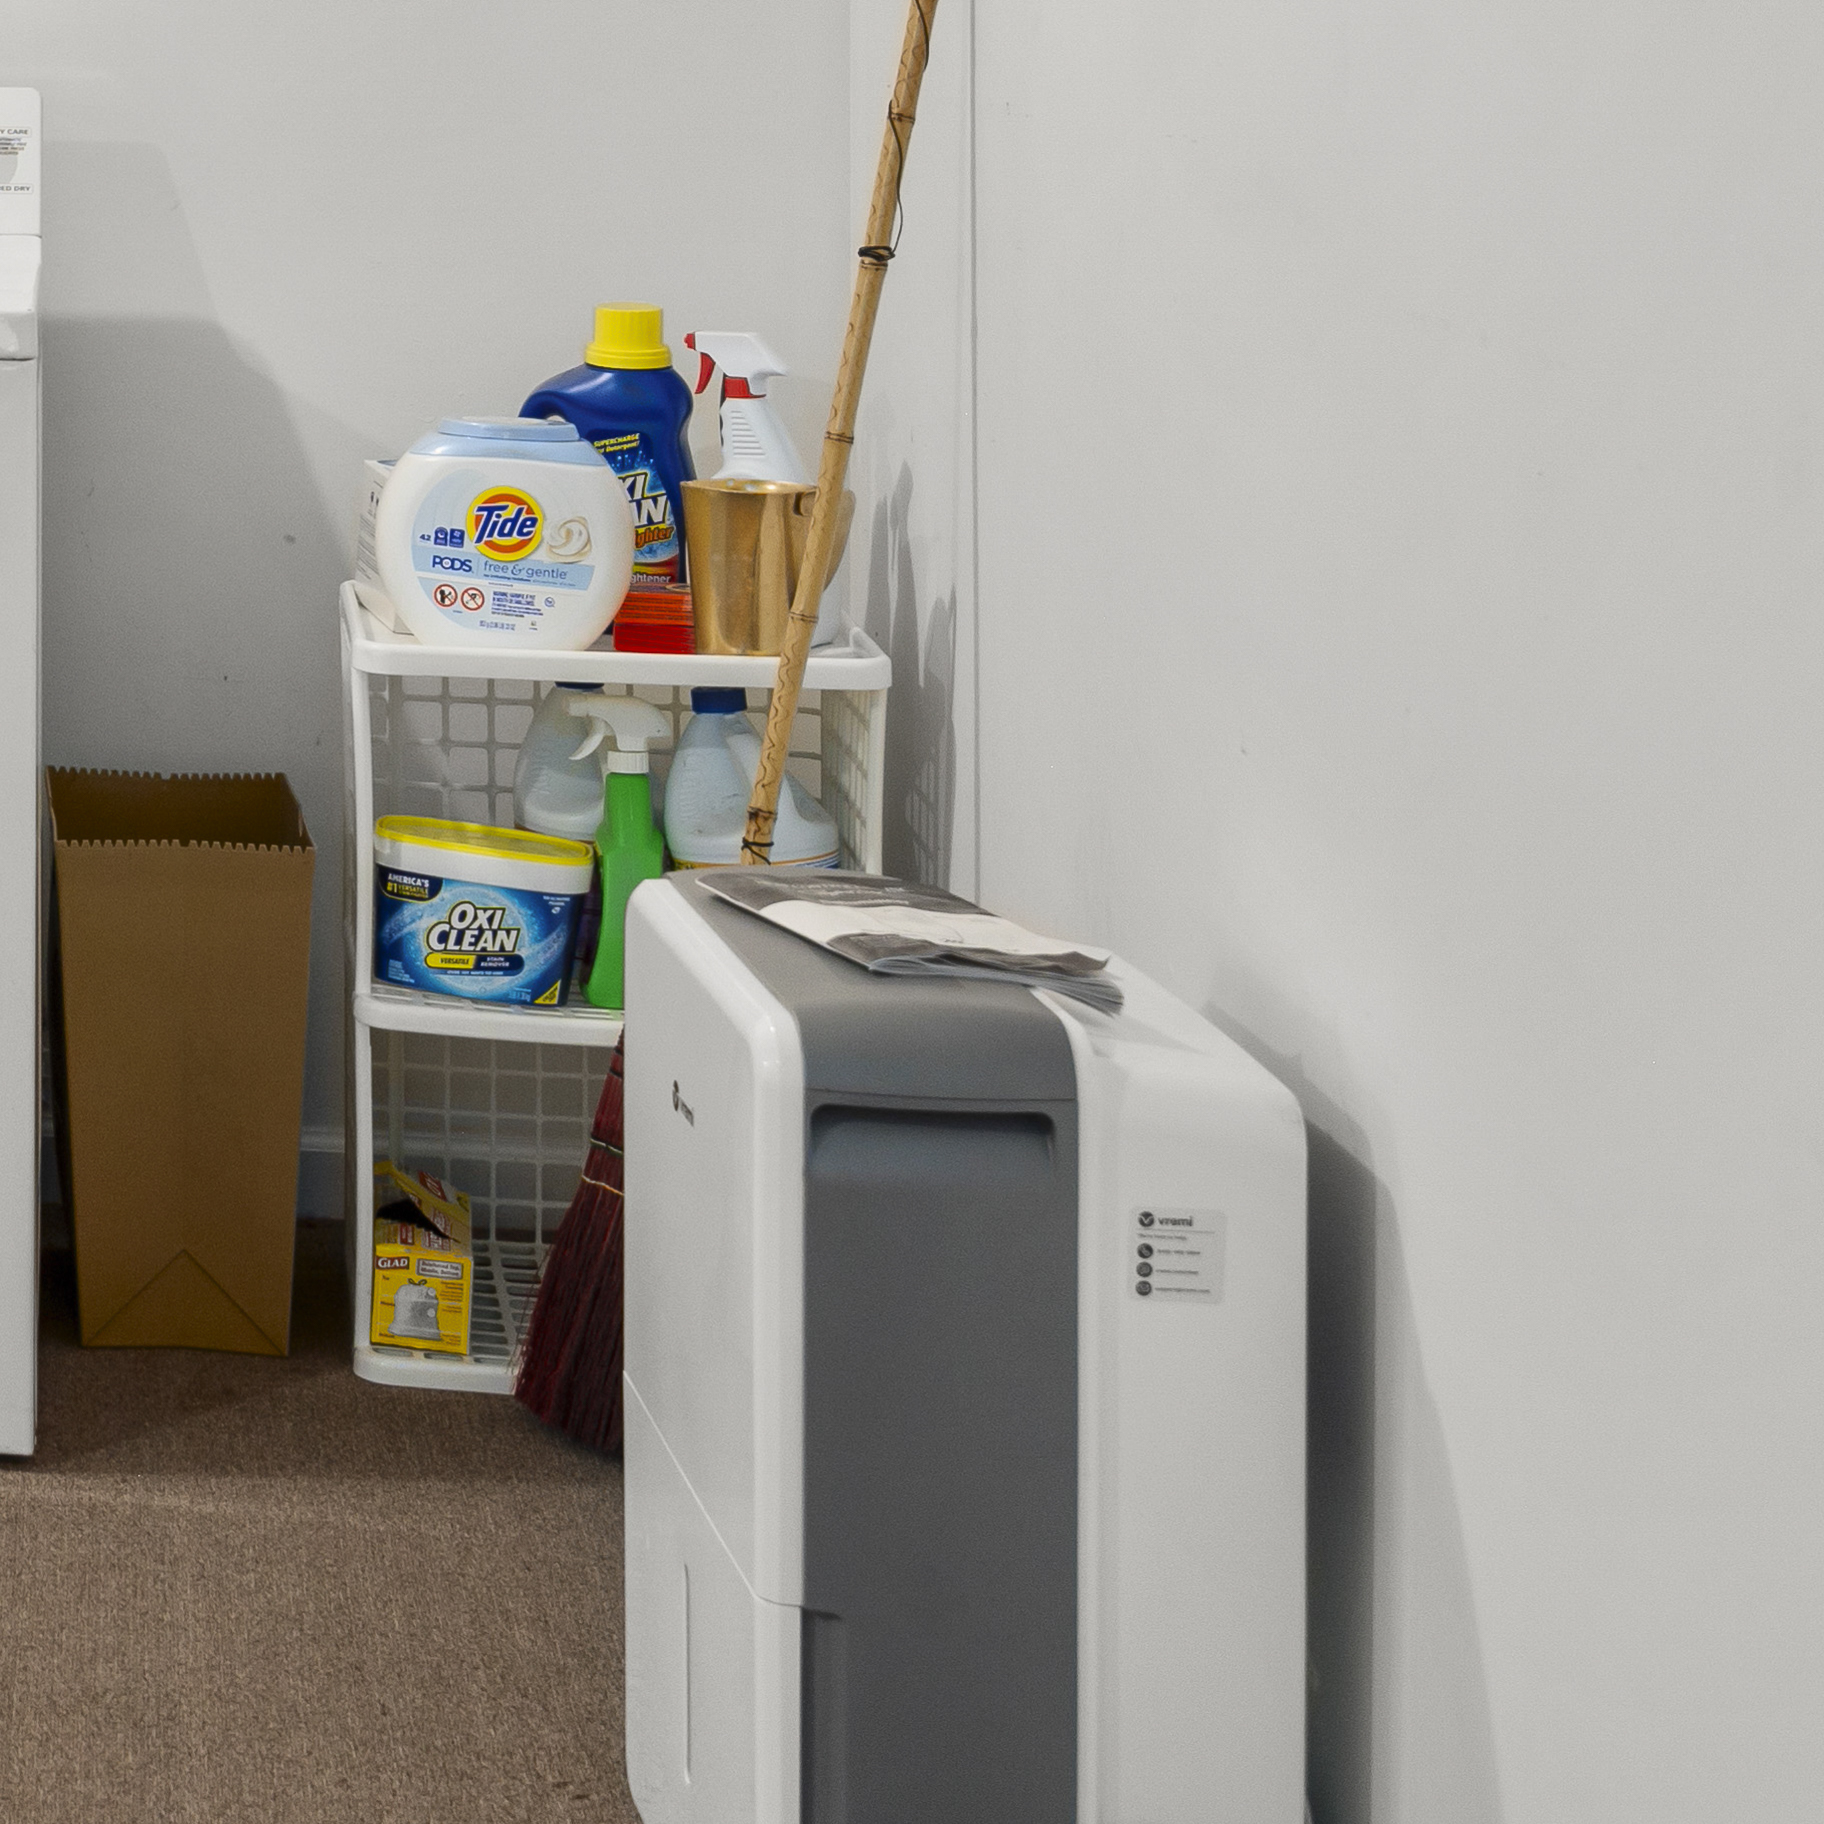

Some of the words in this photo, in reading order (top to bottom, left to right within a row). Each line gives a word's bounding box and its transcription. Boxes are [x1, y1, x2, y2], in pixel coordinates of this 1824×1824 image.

[474, 504, 539, 544] Tide
[432, 555, 472, 573] PODS
[483, 561, 509, 574] free
[525, 566, 567, 580] gentle
[450, 900, 504, 930] OXI
[427, 923, 518, 952] CLEAN
[439, 957, 470, 965] VERSATILE
[377, 1257, 408, 1267] GLAD
